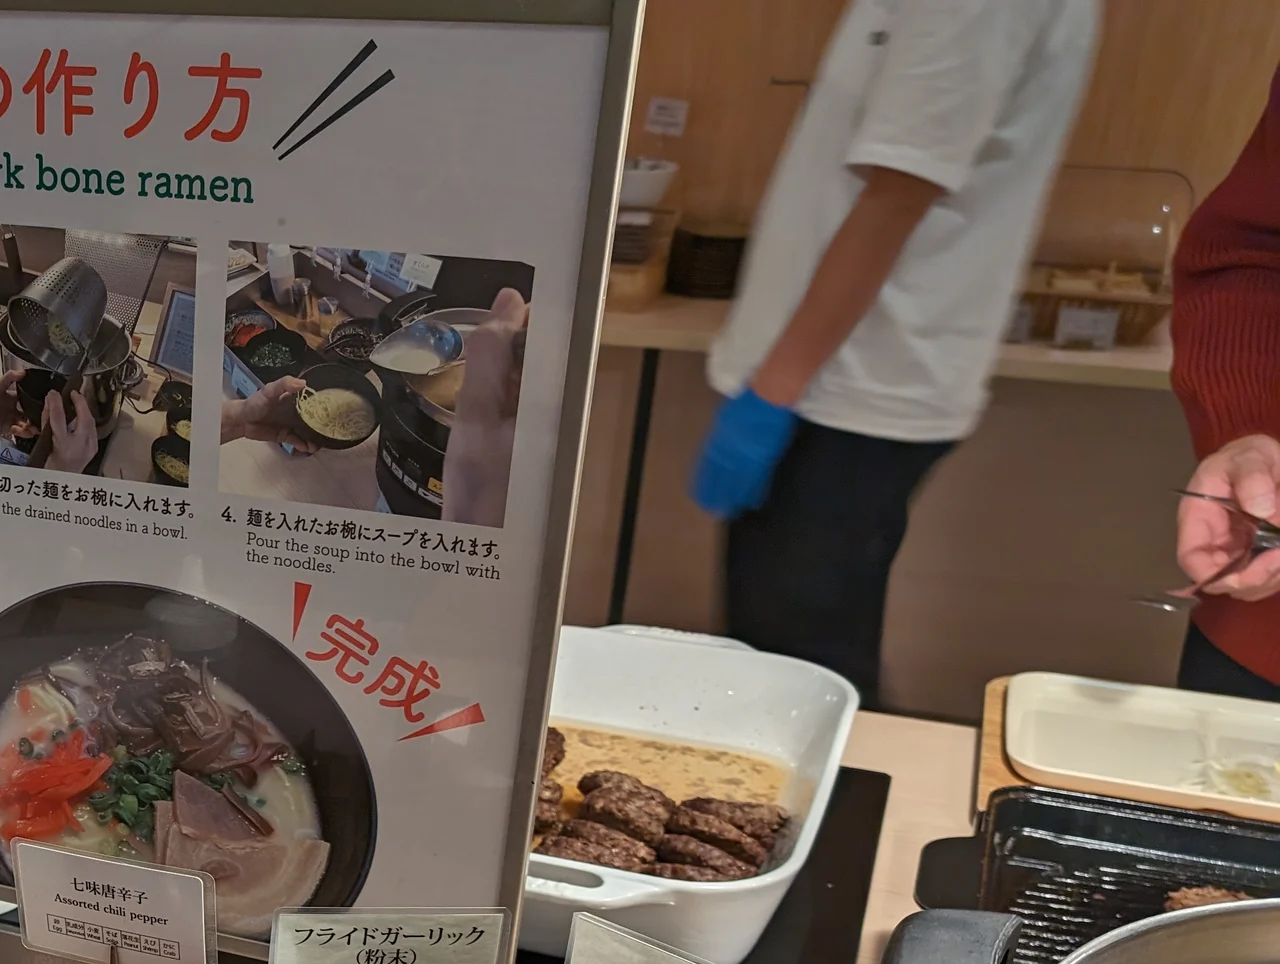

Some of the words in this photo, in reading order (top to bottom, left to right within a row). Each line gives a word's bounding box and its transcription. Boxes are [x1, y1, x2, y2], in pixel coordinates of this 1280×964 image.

[35, 153, 125, 195] bone
[137, 171, 254, 204] ramen
[1, 501, 21, 516] the
[24, 505, 71, 523] drained
[74, 513, 122, 531] noodles
[125, 518, 138, 533] in
[141, 524, 149, 535] a
[152, 522, 188, 540] bowl.
[246, 507, 501, 560] 麺を入れたお椀にスープを入れます。
[246, 531, 281, 549] Pour
[284, 537, 309, 554] the
[313, 545, 350, 563] soup
[354, 546, 385, 564] into
[390, 552, 416, 569] the
[420, 556, 460, 575] bowl
[465, 562, 501, 581] with
[246, 550, 269, 565] the
[273, 554, 336, 574] noodles.
[305, 613, 441, 723] 完成
[54, 893, 100, 912] Assorted
[103, 904, 126, 917] chili
[129, 911, 169, 925] pepper
[70, 877, 149, 905] 七味唐辛子
[294, 926, 485, 946] フライドガーリック
